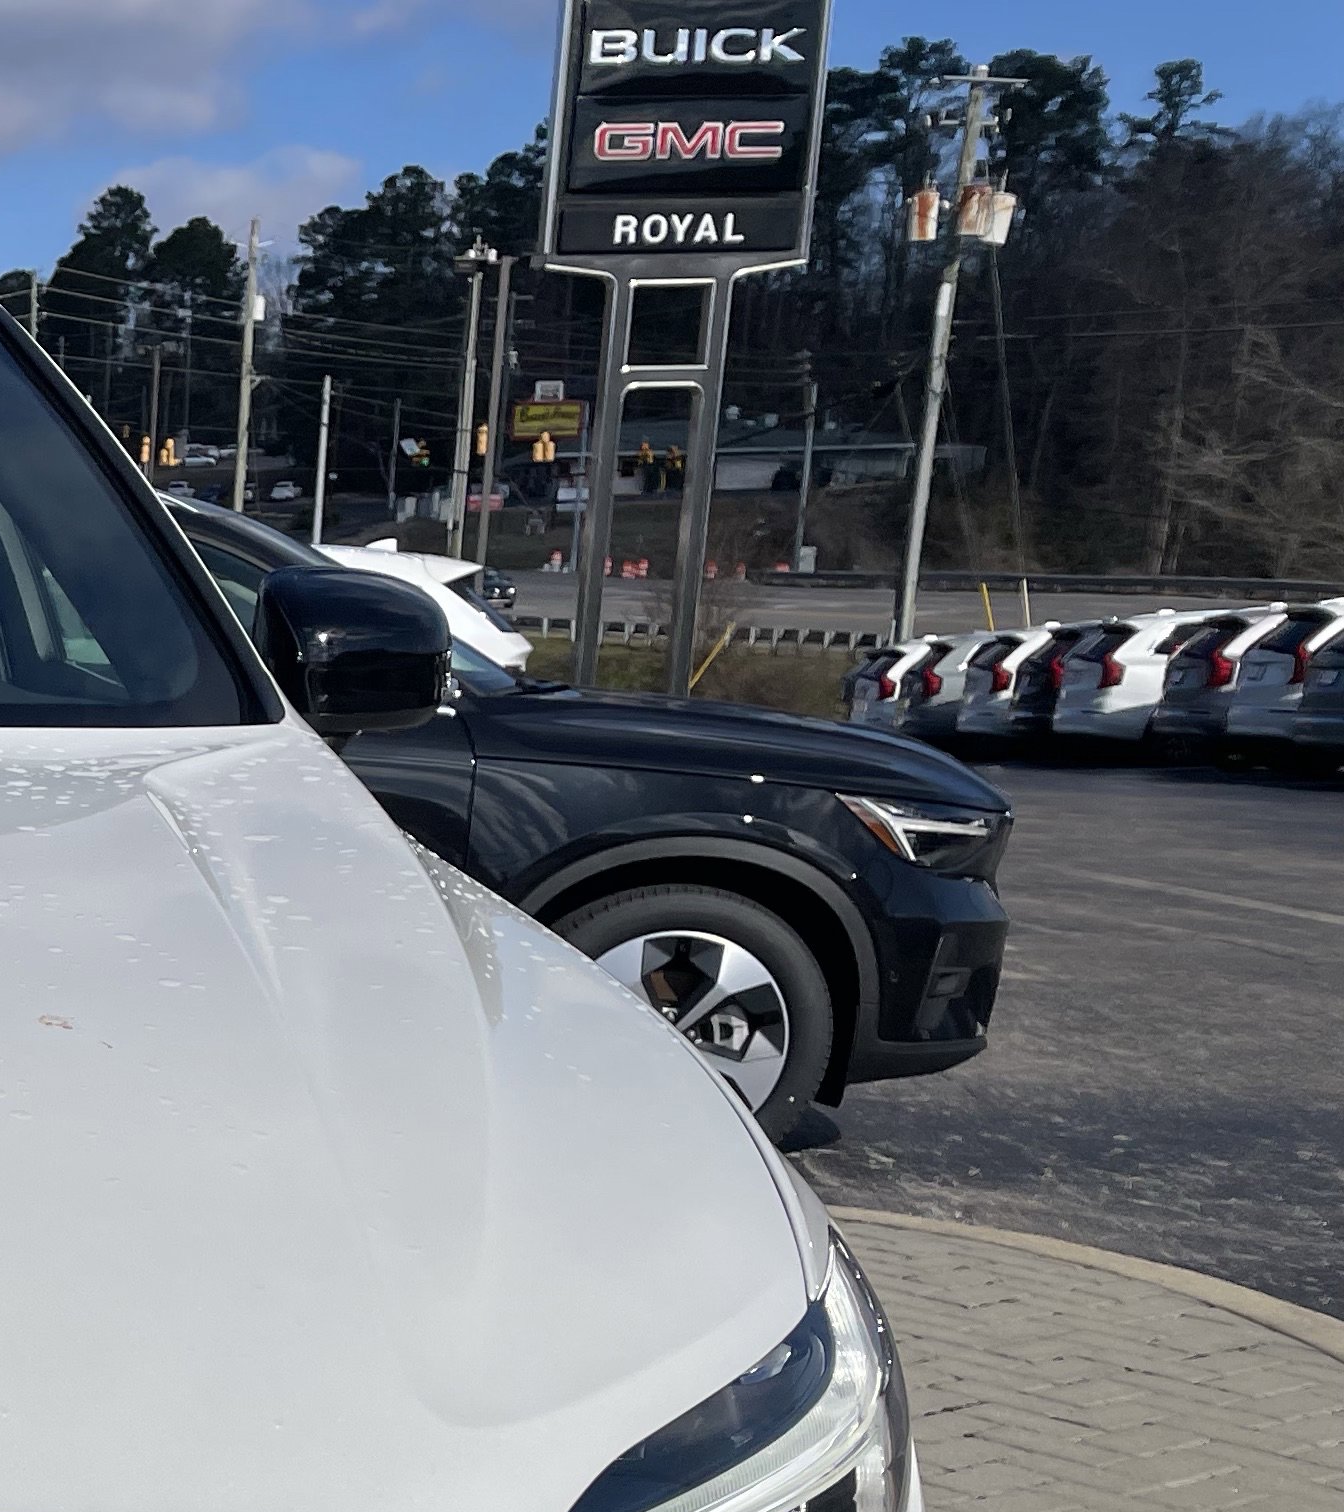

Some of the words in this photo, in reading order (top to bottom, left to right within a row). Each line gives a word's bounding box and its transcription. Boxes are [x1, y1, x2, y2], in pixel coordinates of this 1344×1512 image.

[589, 27, 807, 65] BUICK
[594, 120, 785, 160] GMC
[613, 213, 745, 245] ROYAL
